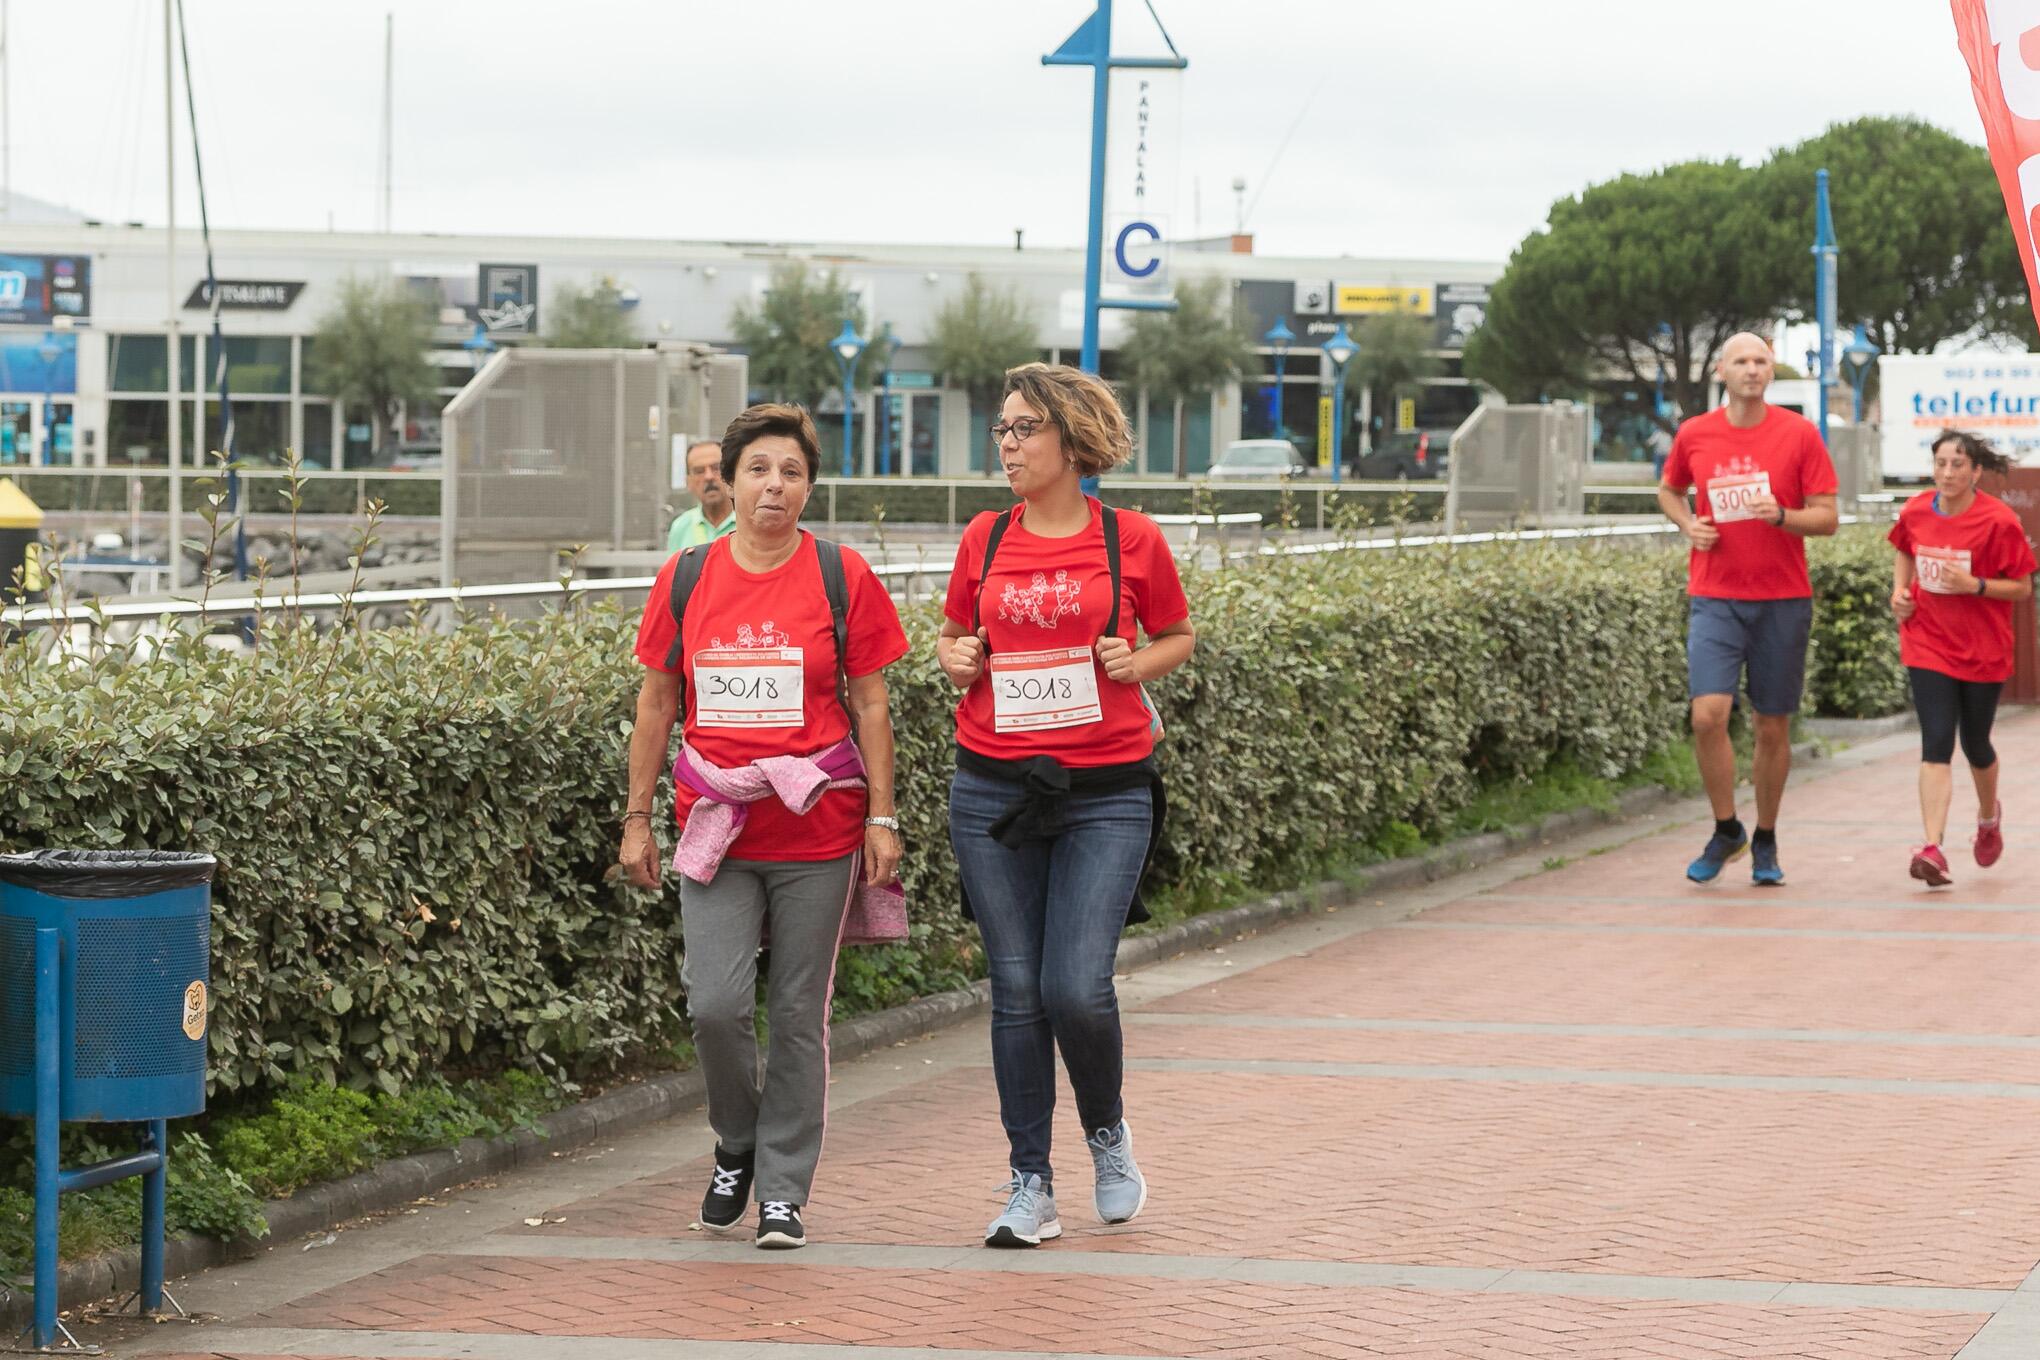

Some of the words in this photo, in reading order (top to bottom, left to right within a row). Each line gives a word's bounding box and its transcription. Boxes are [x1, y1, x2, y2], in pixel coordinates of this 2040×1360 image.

[1115, 222, 1161, 278] C
[709, 675, 779, 699] 3018
[1004, 677, 1073, 700] 3018
